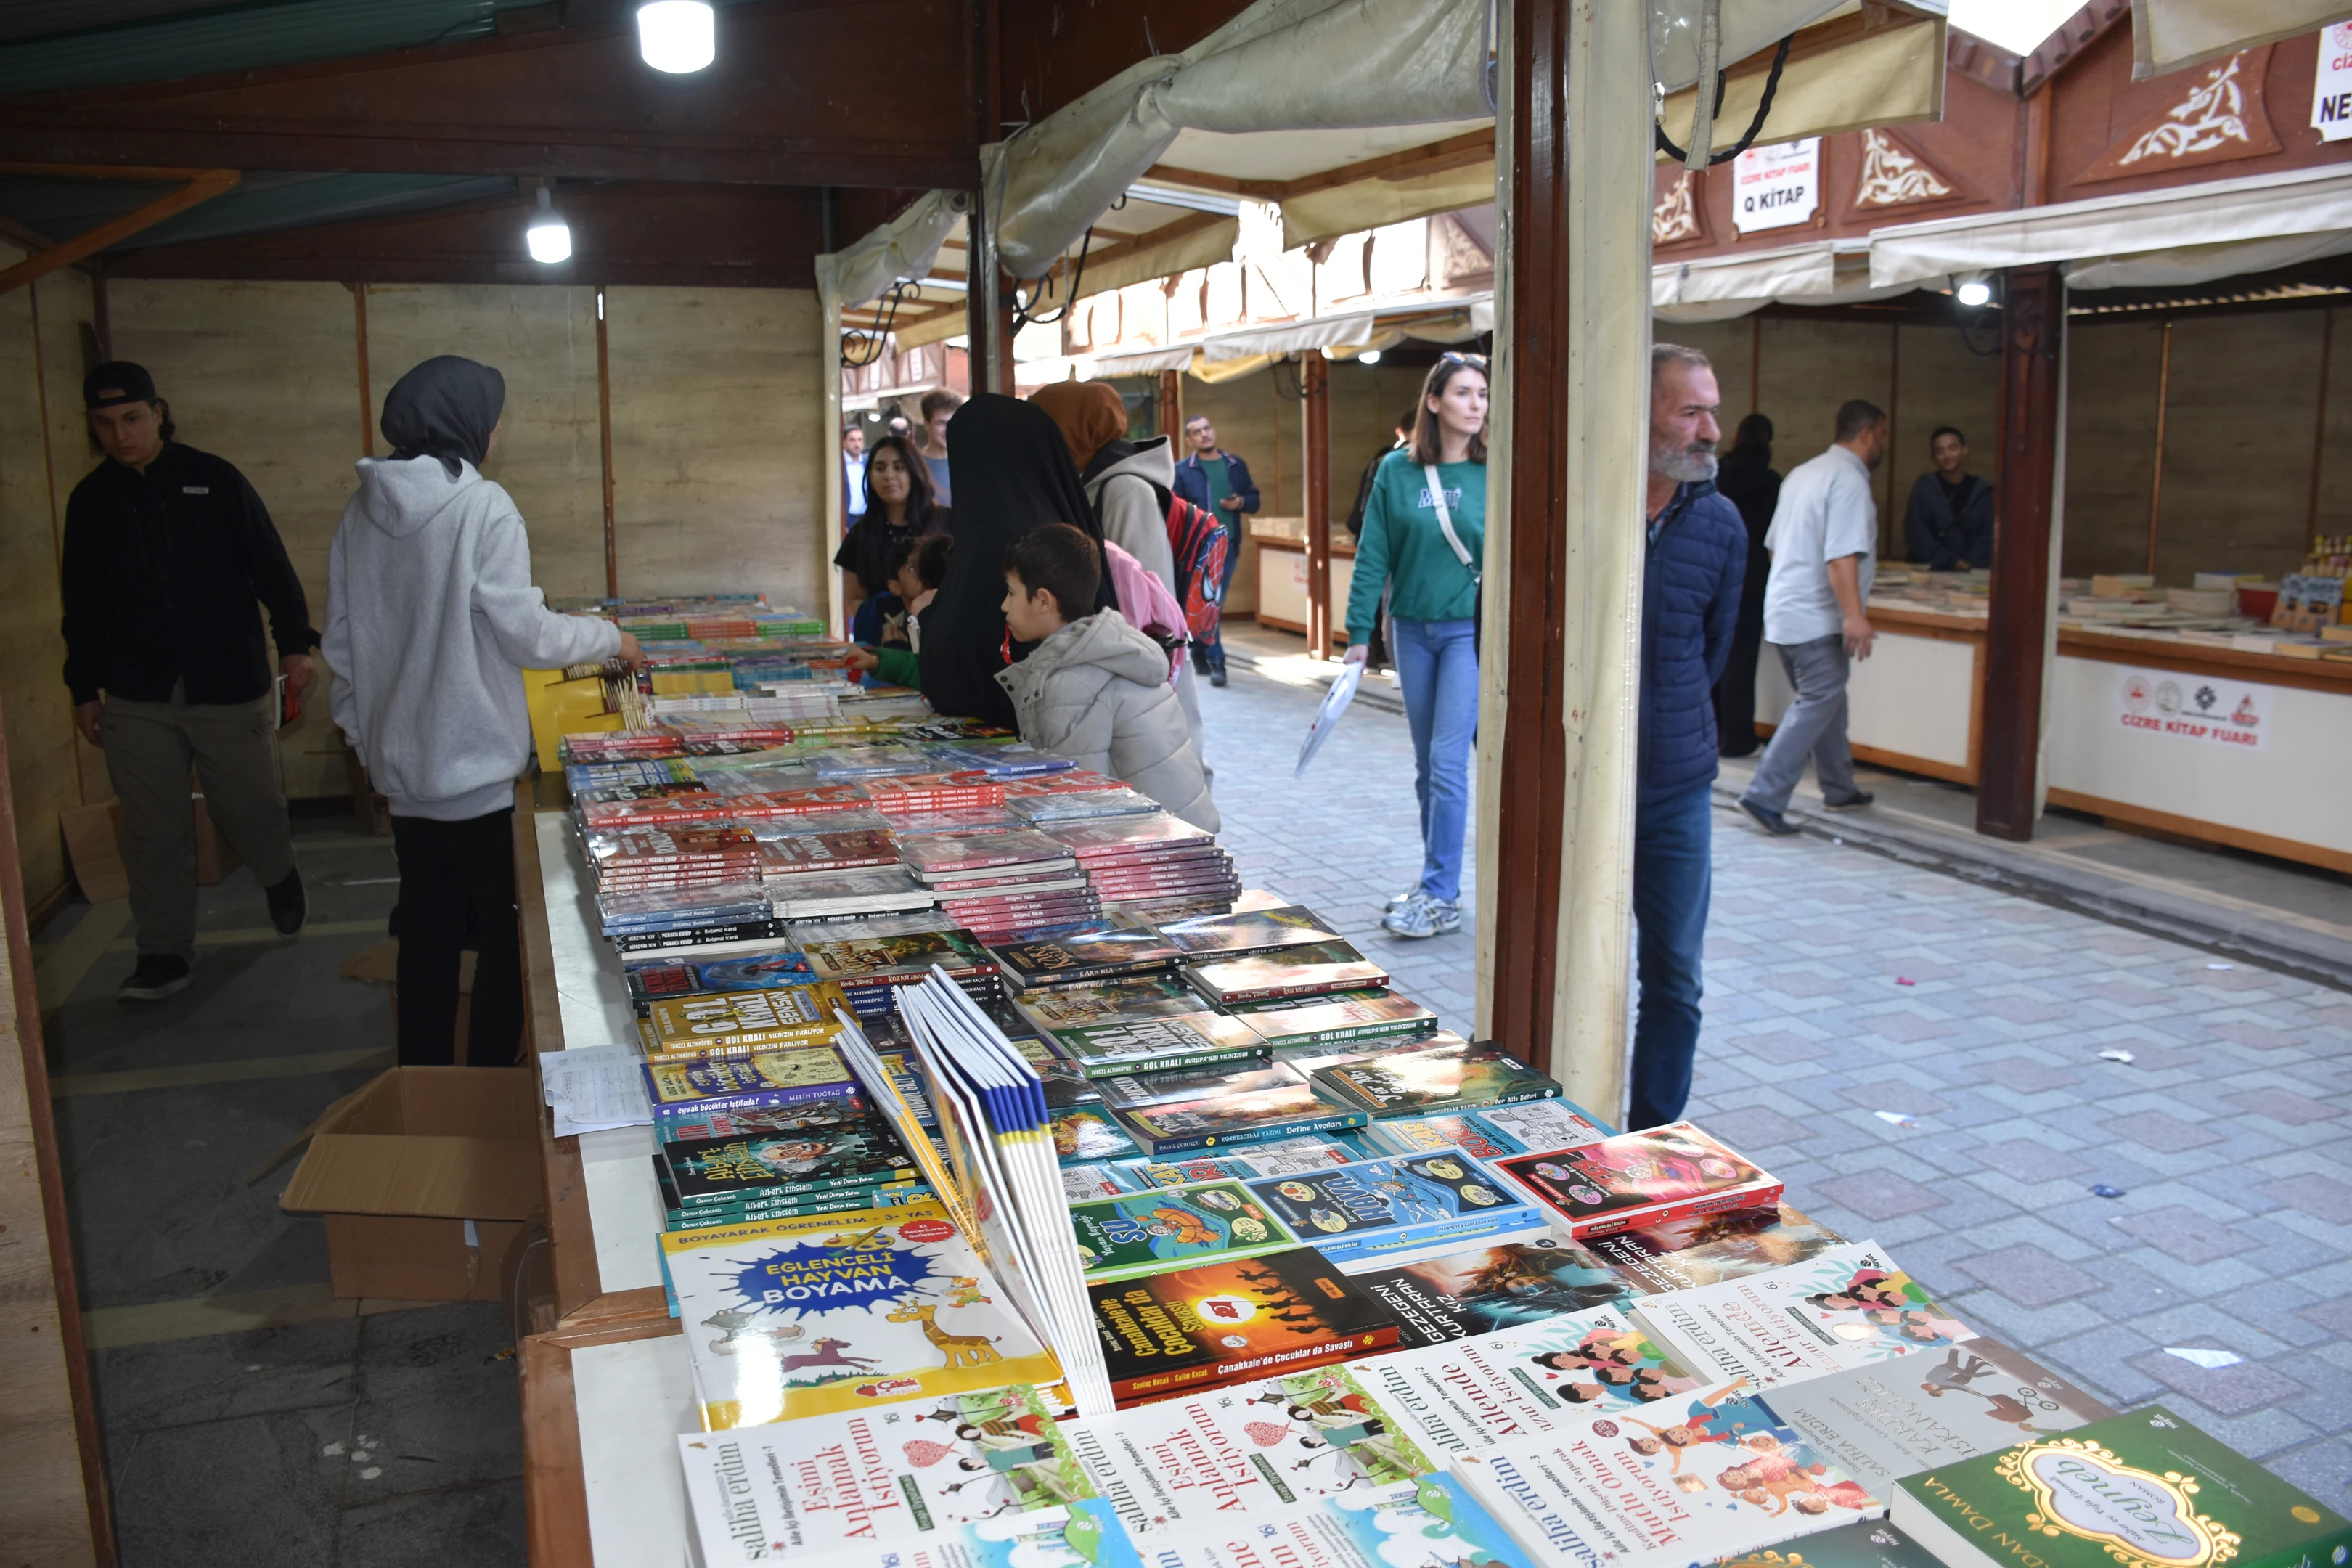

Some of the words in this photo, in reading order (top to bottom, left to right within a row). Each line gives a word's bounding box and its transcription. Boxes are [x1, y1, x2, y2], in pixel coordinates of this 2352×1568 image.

[2320, 93, 2352, 123] NE
[1744, 196, 1755, 213] Q
[1760, 187, 1804, 210] KİTAP
[2121, 714, 2161, 731] CİZRE
[2165, 720, 2208, 738] KİTAP
[2212, 728, 2258, 746] FUARI
[687, 1038, 712, 1048] ALTINKÖPRÜ
[725, 1035, 741, 1045] GOL
[743, 1033, 766, 1042] KRALI
[769, 1030, 794, 1040] YILDIZIN
[796, 1027, 825, 1037] PARLIYOR
[1107, 1064, 1132, 1074] ALTINKÖPRÜ
[1144, 1061, 1158, 1070] GOL
[1159, 1058, 1182, 1069] KRALI
[677, 1106, 698, 1115] eyvah
[789, 1093, 810, 1102] MELİH
[813, 1088, 841, 1099] TUĞTAĞ
[1494, 1098, 1507, 1106] Yer
[1508, 1095, 1519, 1103] Altı
[1519, 1093, 1537, 1102] Şehri
[1286, 1122, 1311, 1134] Define
[1313, 1119, 1342, 1132] Avcıları
[1429, 1116, 1503, 1159] BORA
[696, 1196, 712, 1204] Öznur
[714, 1194, 736, 1203] Çokcanlı
[759, 1186, 783, 1196] Albert
[785, 1183, 812, 1193] Einstein
[829, 1179, 842, 1188] Yeni
[1323, 1177, 1395, 1222] HAVA
[679, 1227, 769, 1245] BOYAYARAK
[907, 1209, 934, 1219] YAŞ
[1099, 1219, 1147, 1244] SU
[1590, 1222, 1614, 1232] EĞLENCELİ
[766, 1251, 897, 1275] EĞLENCELİ
[1318, 1243, 1345, 1252] EĞLENCELİ
[1659, 1249, 1692, 1267] KIZ
[780, 1265, 893, 1287] HAYVAN
[1598, 1241, 1679, 1293] GEZEGENİ
[763, 1275, 910, 1304] BOYAMA
[1125, 1289, 1147, 1305] da
[1390, 1278, 1471, 1339] KURTARAN
[1436, 1293, 1468, 1313] KIZ
[1137, 1302, 1197, 1356] Çocuklar
[1370, 1285, 1447, 1343] GEZEGENİ
[1665, 1302, 1716, 1344] erdim
[1723, 1301, 1812, 1369] Ailemde
[1132, 1380, 1152, 1391] Sevinç
[1153, 1376, 1169, 1387] Koçak
[1175, 1371, 1191, 1382] Salim
[1191, 1368, 1208, 1380] Koçak
[1217, 1354, 1273, 1374] Çanakkale'de
[1275, 1348, 1310, 1368] Çocuklar
[1312, 1344, 1323, 1355] da
[1324, 1339, 1353, 1352] Savaştı
[1460, 1344, 1524, 1404] İstiyorum
[877, 1377, 919, 1392] Çilek
[1379, 1365, 1428, 1411] erdim
[1442, 1363, 1528, 1436] Ailemde
[1793, 1408, 1841, 1440] ERDİM
[1854, 1397, 1942, 1455] KARDEŞ
[1855, 1376, 1983, 1459] ISKANÇLIĞI
[1074, 1429, 1116, 1477] erdim
[1185, 1402, 1260, 1488] İstiyorum
[1839, 1440, 1890, 1477] SALİHA
[847, 1417, 901, 1513] İstiyorum
[1145, 1443, 1196, 1492] Eşimi
[1166, 1427, 1247, 1513] Anlamak
[1490, 1455, 1548, 1511] erdim
[1553, 1447, 1588, 1485] Yaparak
[1571, 1440, 1622, 1490] Olmak
[790, 1459, 831, 1514] Eşimi
[815, 1443, 877, 1540] Anlamak
[1614, 1450, 1692, 1523] İstiyorum
[1924, 1477, 1994, 1532] DAMLA
[2129, 1480, 2166, 1506] ROMAN
[1616, 1514, 1657, 1551] Kendine
[1620, 1491, 1683, 1547] Mutlu
[1612, 1538, 1630, 1553] Aile
